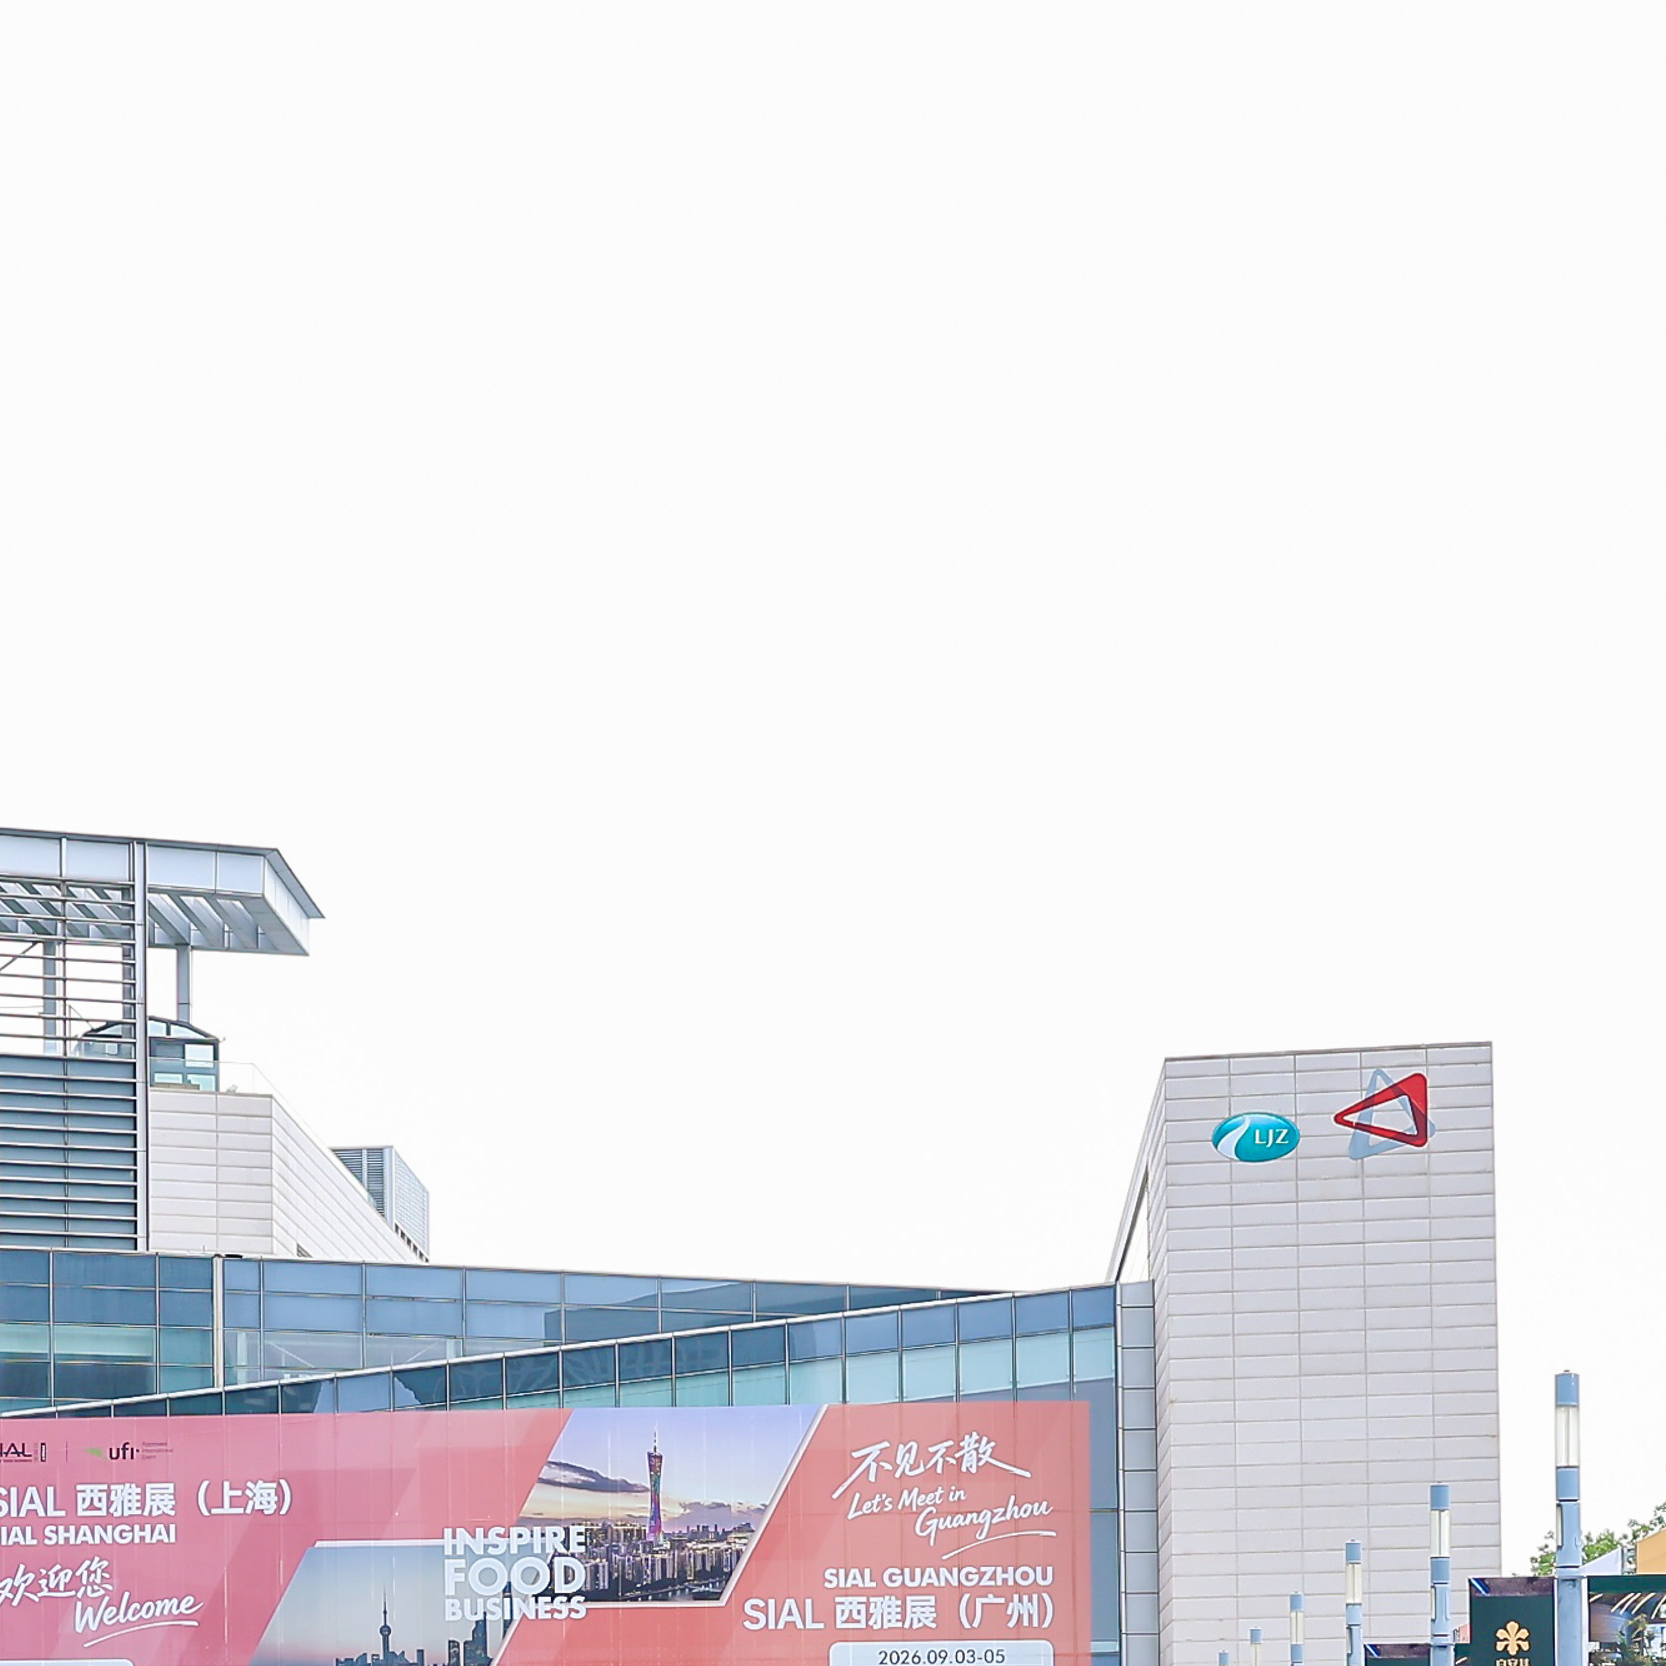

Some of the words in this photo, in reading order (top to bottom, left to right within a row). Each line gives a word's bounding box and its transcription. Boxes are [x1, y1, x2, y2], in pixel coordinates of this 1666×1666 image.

[1255, 1129, 1289, 1147] LJZ
[832, 1431, 1031, 1499] 不见不散
[847, 1493, 893, 1520] Let's
[898, 1486, 944, 1511] Meet
[949, 1486, 966, 1501] in
[44, 1524, 175, 1544] SHANGHAI
[916, 1495, 1053, 1546] Guangzhou
[443, 1526, 586, 1555] INSPIRE
[444, 1556, 586, 1596] FOOD
[824, 1568, 876, 1589] SIAL
[883, 1566, 1053, 1587] GUANGZHOU
[74, 1591, 204, 1633] Welcome
[444, 1596, 587, 1621] BUSINESS
[743, 1598, 824, 1630] SIAL
[879, 1649, 1005, 1665] 2026.09.03-05
